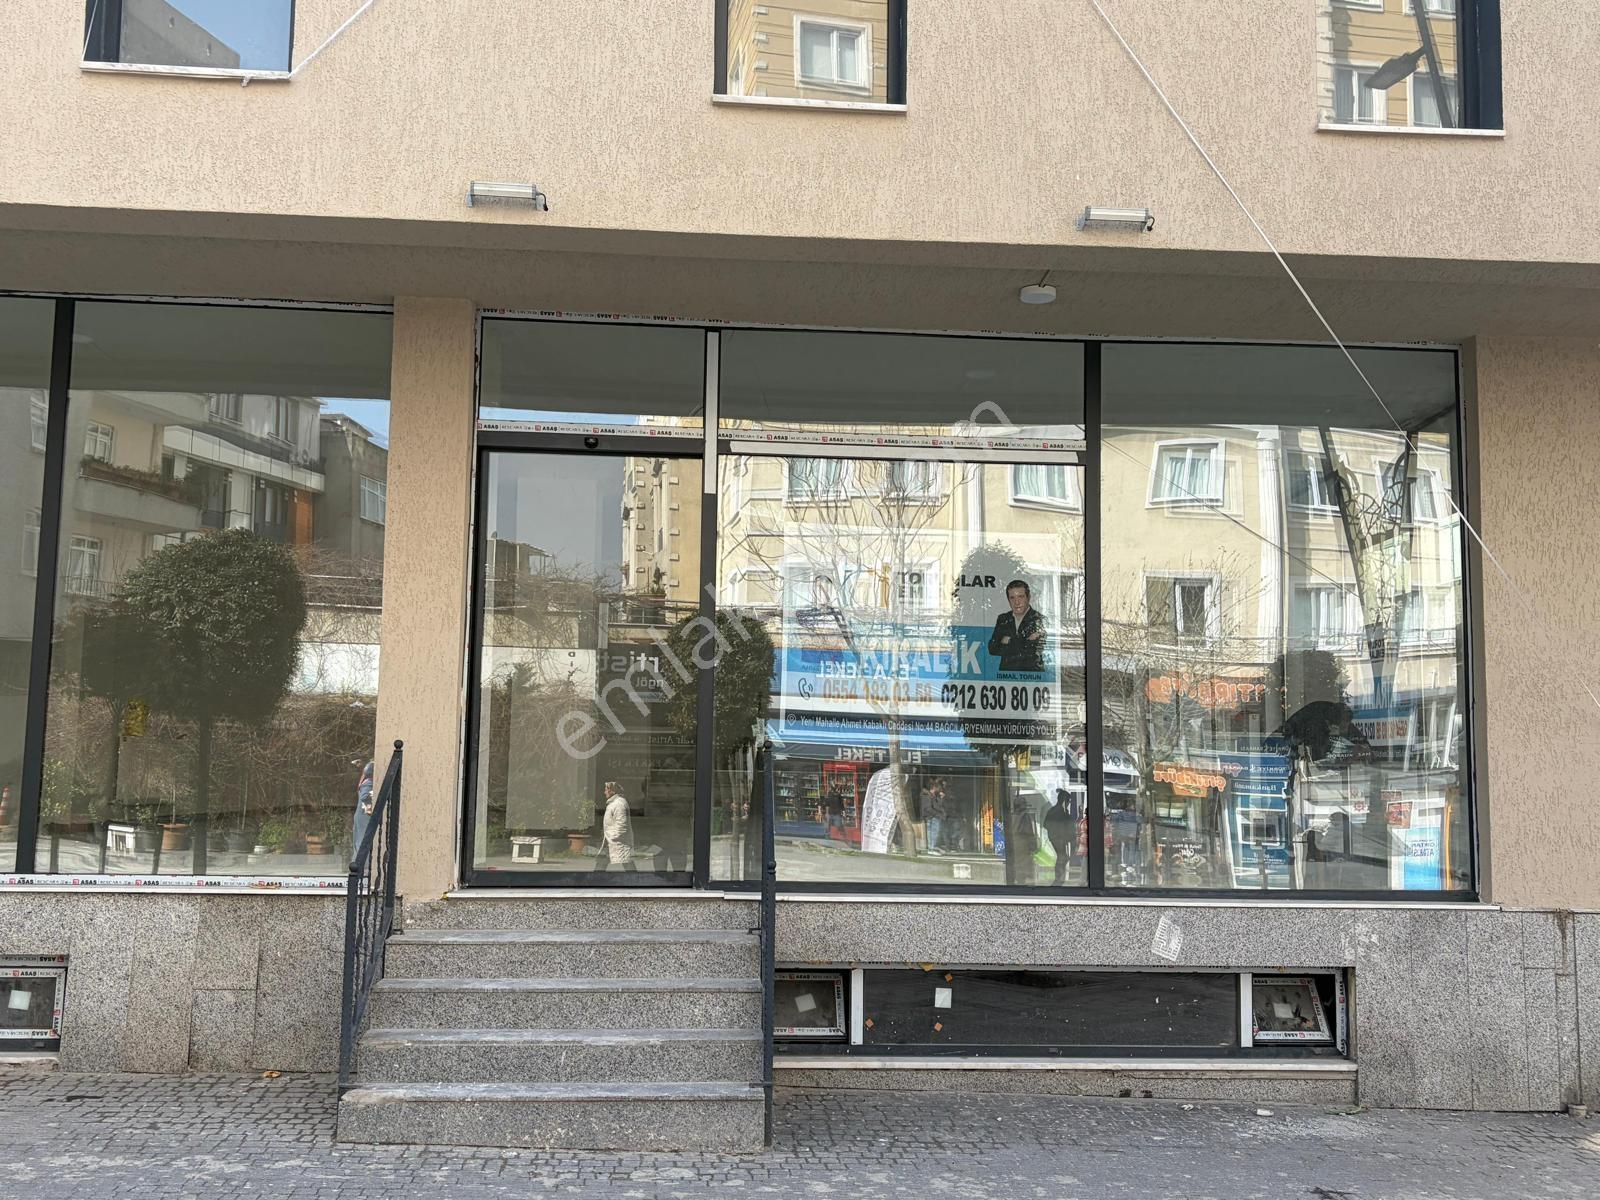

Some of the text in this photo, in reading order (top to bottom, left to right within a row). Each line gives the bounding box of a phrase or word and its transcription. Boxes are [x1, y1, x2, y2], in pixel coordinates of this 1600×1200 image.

[941, 683, 976, 709] 0212
[980, 685, 1007, 711] 630
[1011, 686, 1028, 711] 80
[841, 718, 862, 728] Ahmet
